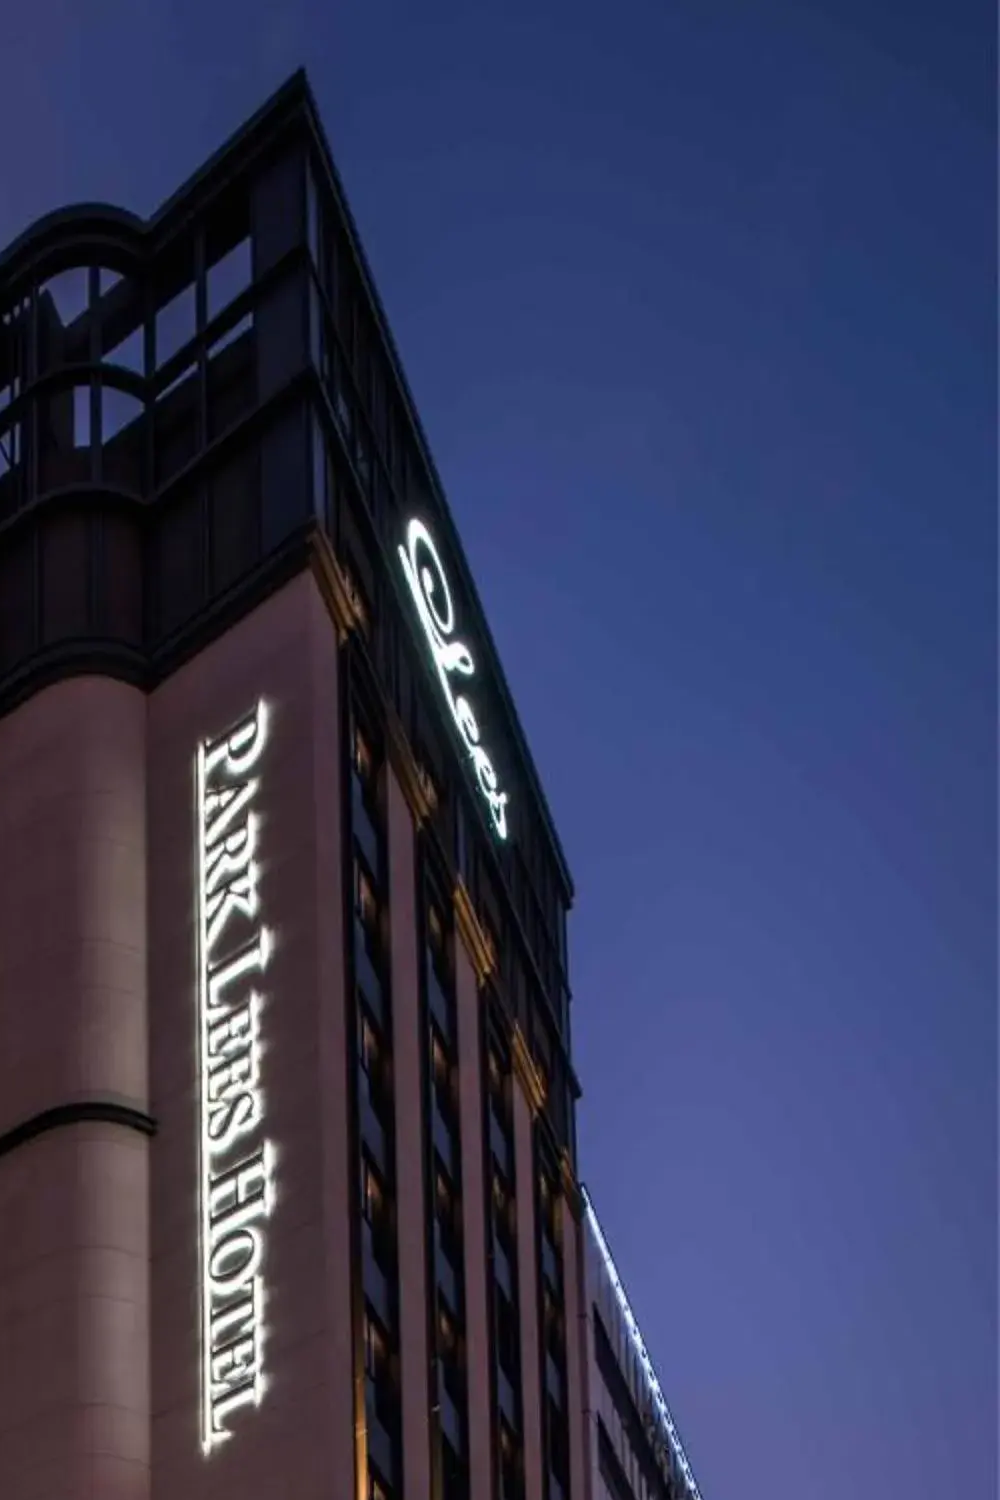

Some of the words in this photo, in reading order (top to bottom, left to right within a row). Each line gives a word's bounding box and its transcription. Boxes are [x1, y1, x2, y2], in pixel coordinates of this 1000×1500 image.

[204, 698, 269, 947] PARK
[204, 924, 275, 1152] LEES
[206, 1138, 276, 1446] HOTEL
